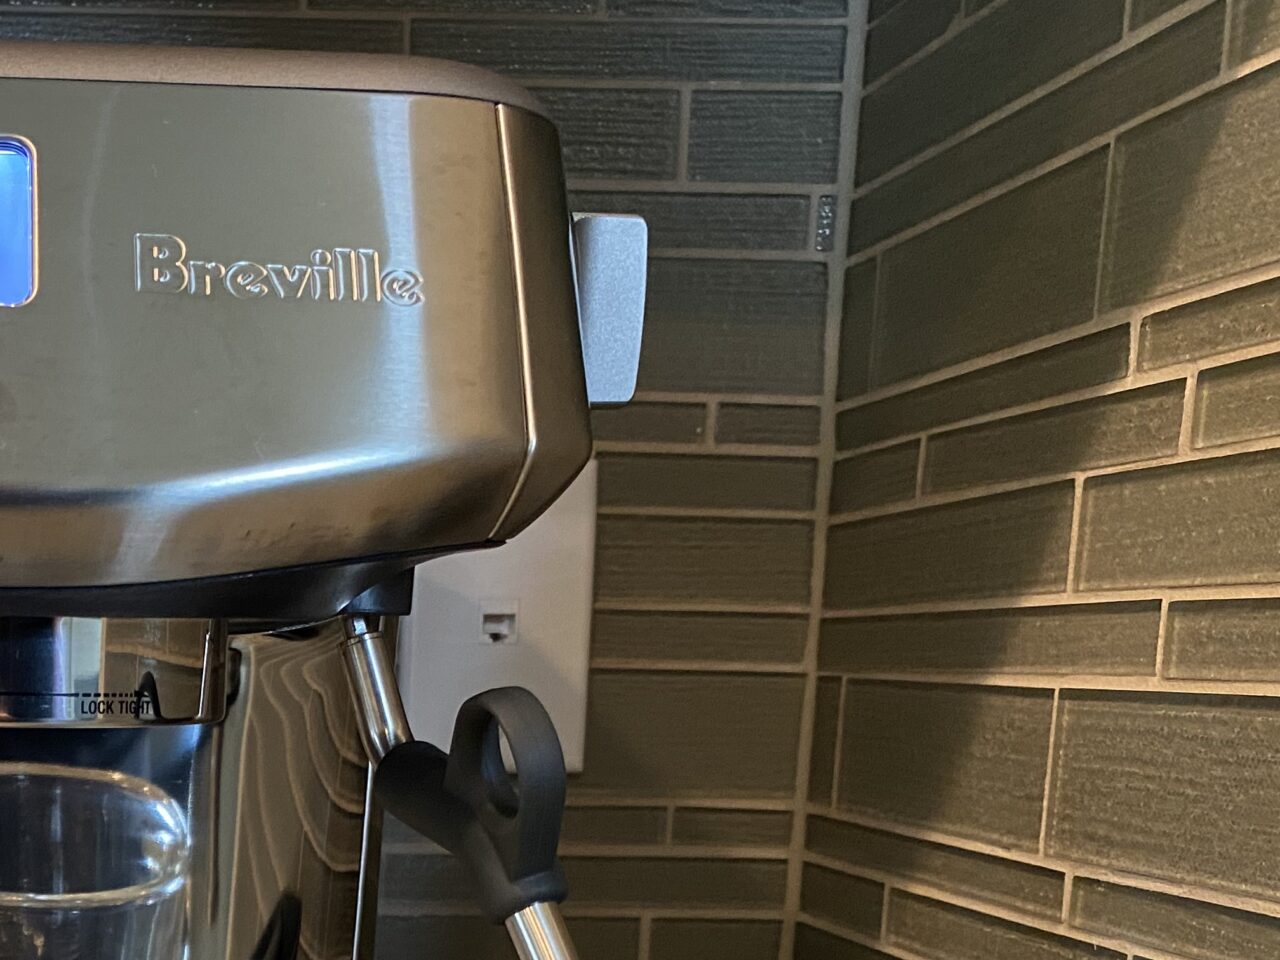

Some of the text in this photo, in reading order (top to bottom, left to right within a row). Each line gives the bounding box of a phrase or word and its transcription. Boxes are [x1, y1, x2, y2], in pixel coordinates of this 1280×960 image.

[133, 233, 426, 307] Breville
[80, 700, 151, 715] LOCK TIGHT
